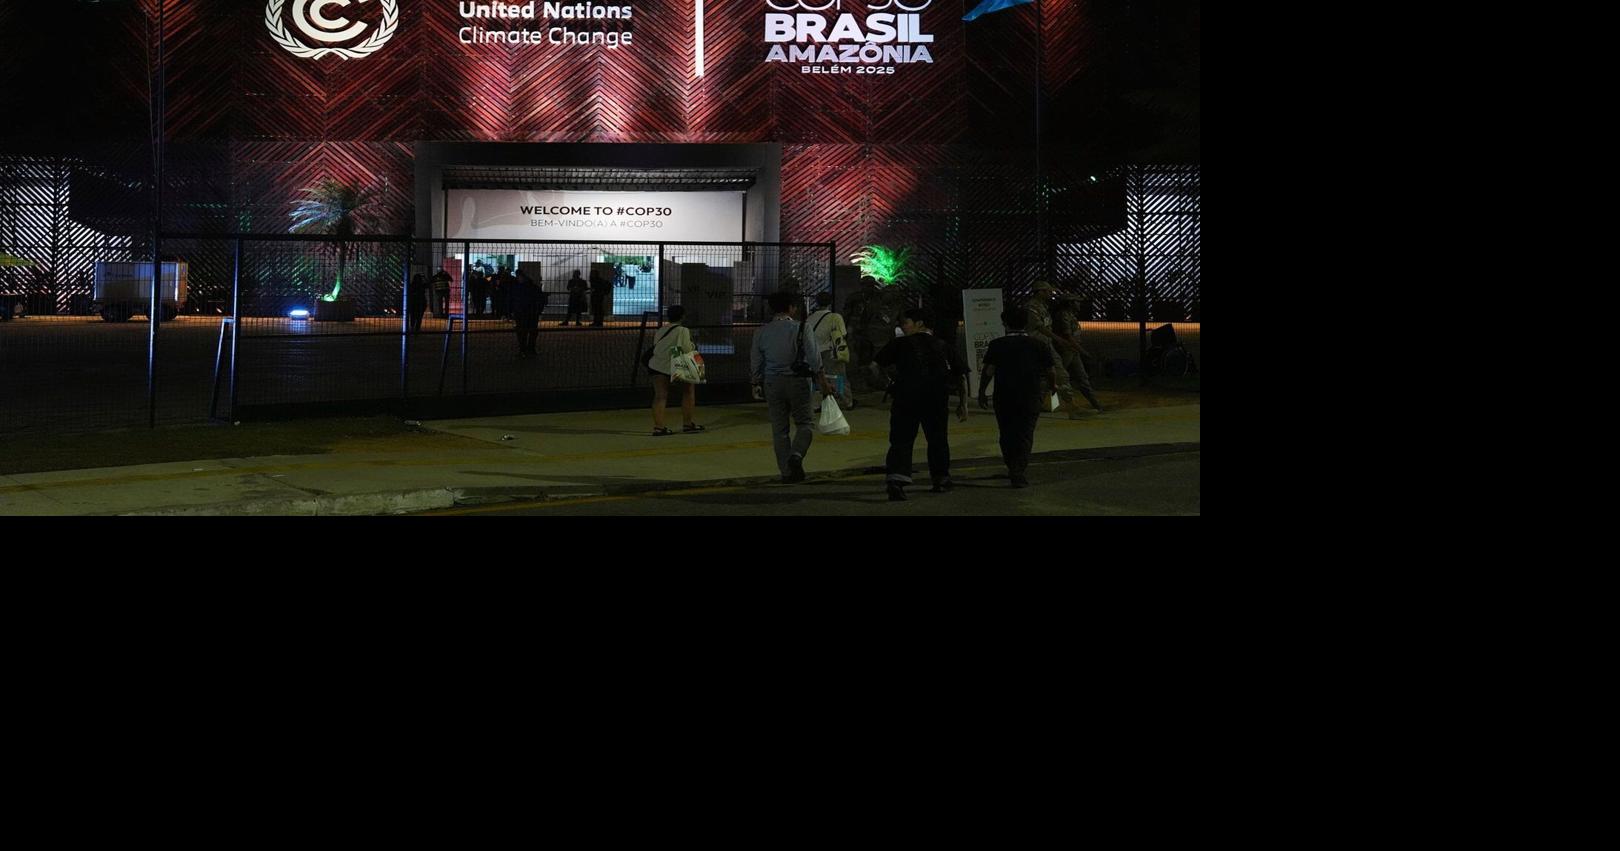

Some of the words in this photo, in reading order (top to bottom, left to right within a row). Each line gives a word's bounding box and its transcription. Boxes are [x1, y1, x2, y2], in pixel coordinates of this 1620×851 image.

[459, 1, 535, 18] United
[543, 1, 632, 19] Nations
[764, 13, 934, 43] BRASIL
[459, 27, 541, 44] Climate
[549, 27, 633, 48] Change
[765, 41, 934, 63] AMAZÔNIA
[801, 64, 851, 74] BELÉM
[856, 66, 895, 74] 2025
[520, 206, 591, 215] WELCOME
[594, 206, 613, 216] TO
[617, 207, 672, 216] #COP30
[530, 219, 607, 227] BEM-VINDO(A)
[620, 220, 663, 228] #COP30
